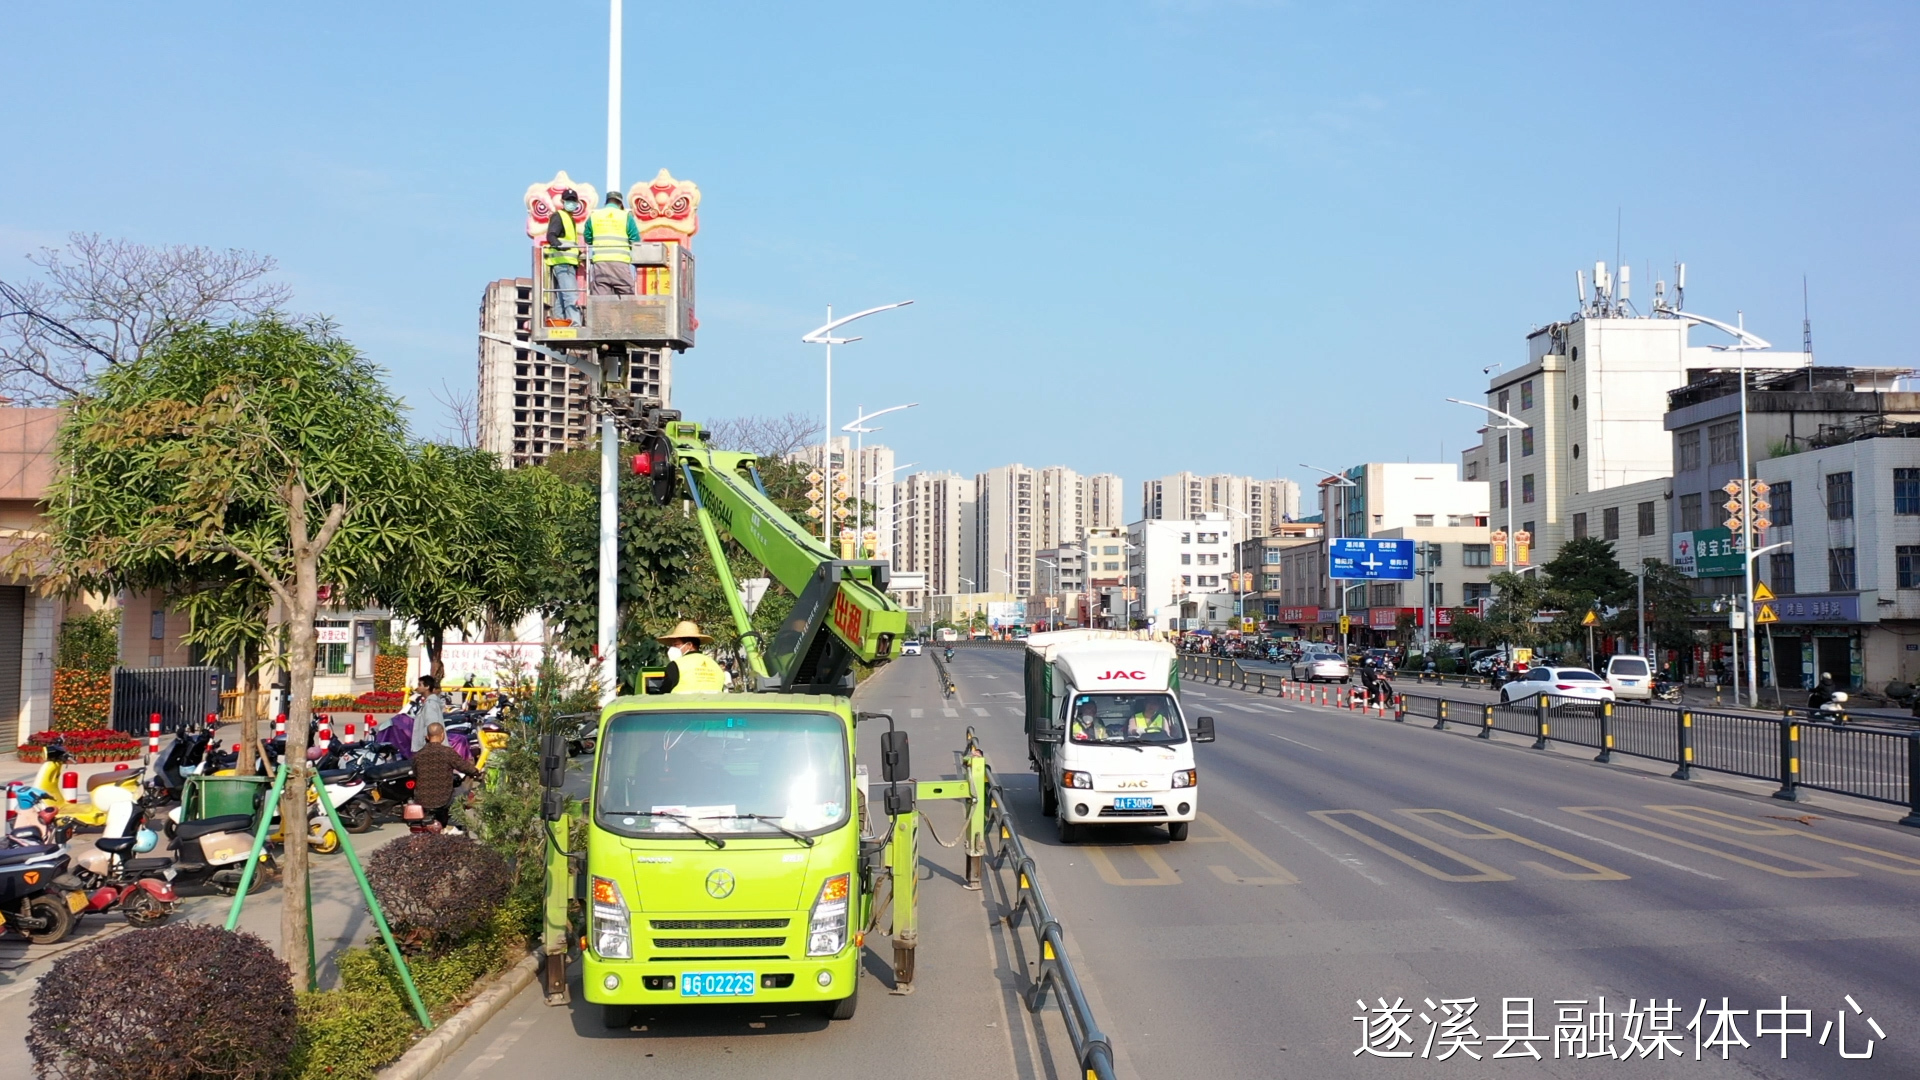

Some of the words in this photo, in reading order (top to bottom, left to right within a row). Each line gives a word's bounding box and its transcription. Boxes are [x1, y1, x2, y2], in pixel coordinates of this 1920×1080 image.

[1697, 536, 1745, 558] 俊宝五金
[834, 591, 862, 647] 出租
[1097, 670, 1147, 680] JAC
[1117, 779, 1149, 788] JAC
